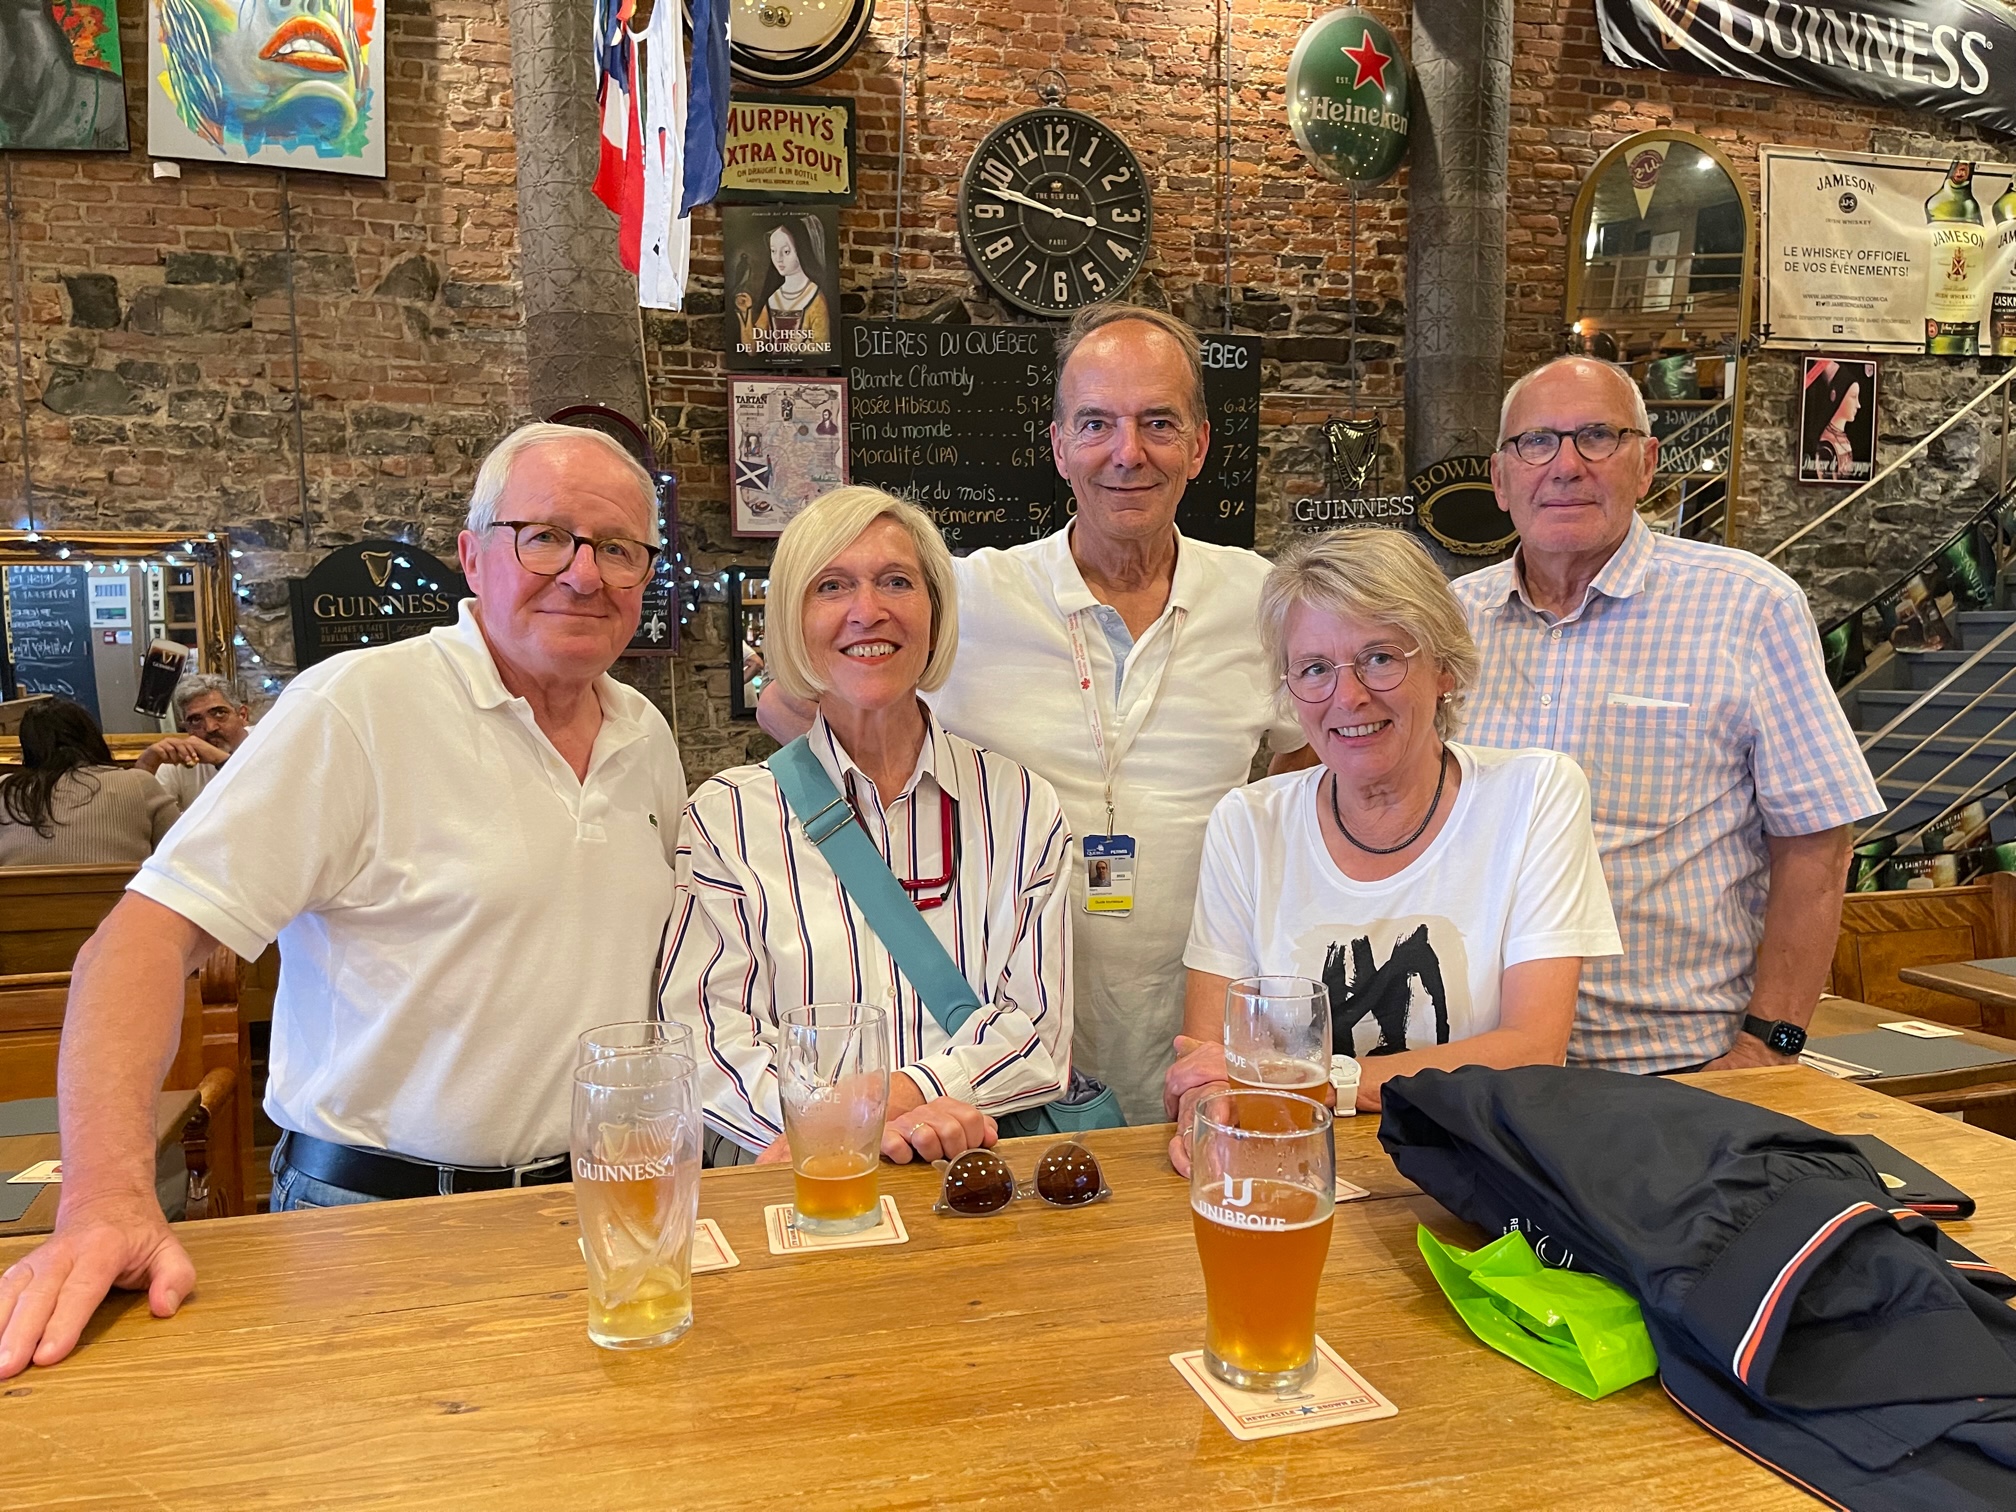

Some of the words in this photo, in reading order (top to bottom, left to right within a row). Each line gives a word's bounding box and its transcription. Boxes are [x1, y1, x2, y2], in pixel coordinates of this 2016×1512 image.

[1718, 0, 1989, 96] GUINNESS
[1335, 76, 1351, 85] EST.
[1310, 96, 1409, 136] Heineken
[1006, 130, 1038, 167] 11
[1044, 124, 1070, 156] 12
[726, 142, 777, 167] XTRA
[782, 138, 842, 177] STOUT
[1079, 137, 1100, 168] 1
[737, 170, 747, 178] ON
[748, 166, 777, 176] DRAUGHT
[779, 166, 785, 175] &
[794, 169, 818, 181] BOTTLE
[980, 158, 1014, 189] 10
[1101, 167, 1130, 191] 2
[1816, 173, 1875, 195] JAMESON
[1035, 192, 1049, 200] THE
[974, 204, 1005, 219] 9
[1111, 208, 1141, 223] 3
[985, 236, 1014, 260] 8
[1106, 239, 1134, 262] 4
[1933, 230, 1985, 250] JAMESON
[1783, 246, 1798, 257] LE
[1801, 247, 1853, 260] WHISKEY
[1857, 250, 1910, 262] OFFICIEL
[1017, 260, 1038, 290] 7
[1081, 261, 1105, 293] 5
[1784, 261, 1799, 272] DE
[1803, 262, 1827, 273] VOS
[1830, 260, 1909, 277] ÉVÉNEMENTS!
[1053, 271, 1068, 302] 6
[752, 327, 815, 340] DUCHESSE
[853, 325, 928, 358] BIÈRES
[940, 332, 960, 357] DU
[965, 329, 1039, 355] QUÉBEC
[736, 343, 752, 353] DE
[755, 341, 832, 353] BOURGOGNE
[1200, 339, 1248, 369] ÉBEC
[851, 366, 904, 391] Blanche
[908, 364, 975, 396] Chambly
[1026, 364, 1054, 387] 5%
[735, 395, 768, 405] TARTAN
[895, 396, 951, 415] Hibiscus
[850, 421, 877, 442] Fin
[881, 420, 899, 439] du
[902, 419, 952, 439] monde
[1023, 419, 1051, 443] 9%
[1223, 417, 1250, 436] 5%
[851, 444, 924, 467] Moralité
[926, 443, 959, 467] (IPA)
[1222, 443, 1251, 467] 7%
[1411, 458, 1491, 495] BOWM
[933, 480, 950, 500] du
[1028, 502, 1052, 525] 5%
[1219, 499, 1246, 518] 9%
[1295, 496, 1415, 522] GUINNESS
[313, 593, 450, 618] GUINNESS
[353, 633, 385, 641] IRAND
[577, 1158, 665, 1182] GUINNESS
[1198, 1200, 1286, 1232] UNIBROUE
[1244, 1409, 1296, 1423] NEWCASTLE
[1316, 1401, 1348, 1411] BROWN
[1350, 1398, 1366, 1406] ALE
